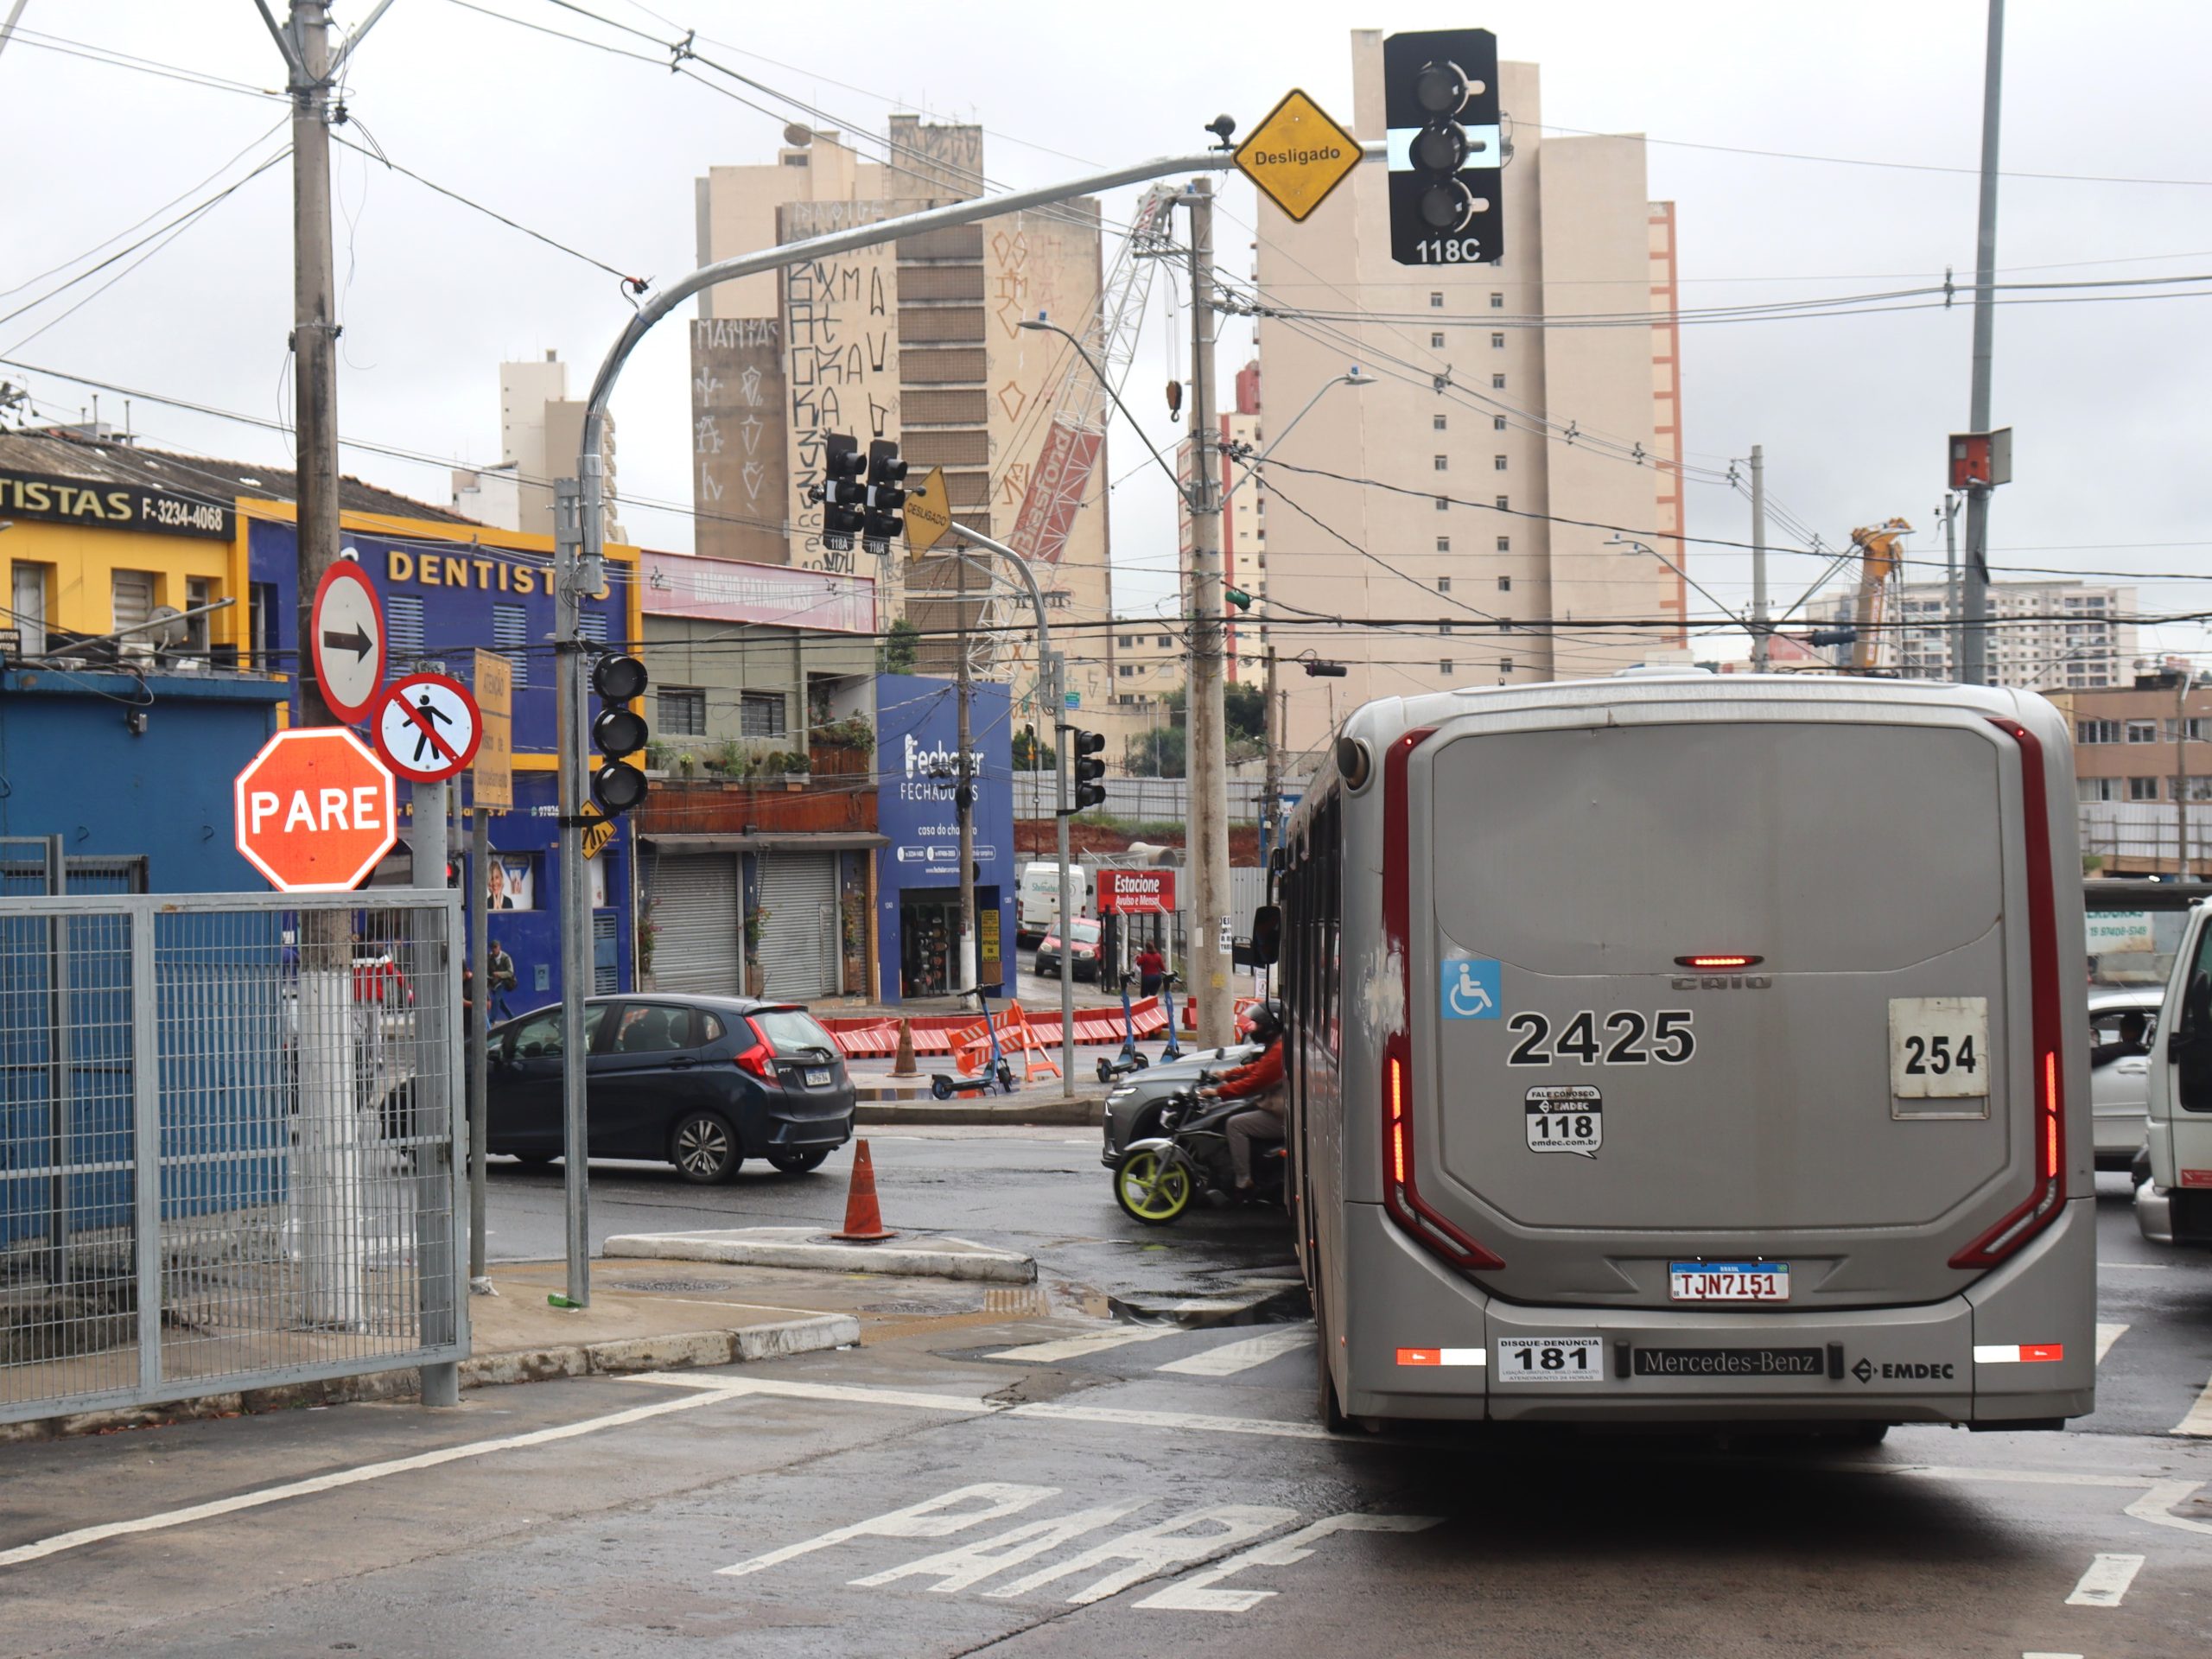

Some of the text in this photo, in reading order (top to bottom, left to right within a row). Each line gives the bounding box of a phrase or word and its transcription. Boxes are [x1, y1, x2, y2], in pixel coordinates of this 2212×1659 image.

[1255, 146, 1341, 165] Desligado
[1416, 238, 1481, 263] 118C
[143, 499, 223, 531] F-3234-4068
[907, 503, 947, 526] DESLIGADO
[830, 537, 849, 550] 118A
[868, 543, 886, 554] 118A
[251, 785, 380, 835] PARE
[918, 826, 935, 836] casa
[937, 823, 946, 836] do
[1115, 874, 1160, 893] Estacione
[1506, 1009, 1697, 1067] 2425
[1905, 1035, 1976, 1074] 254
[1554, 1102, 1589, 1111] EMDEC
[1535, 1116, 1593, 1138] 118
[1514, 1348, 1587, 1370] 181
[1643, 1351, 1815, 1372] Mercedes-Benz
[1882, 1363, 1954, 1380] EMDEC
[713, 1483, 1448, 1612] PARE
